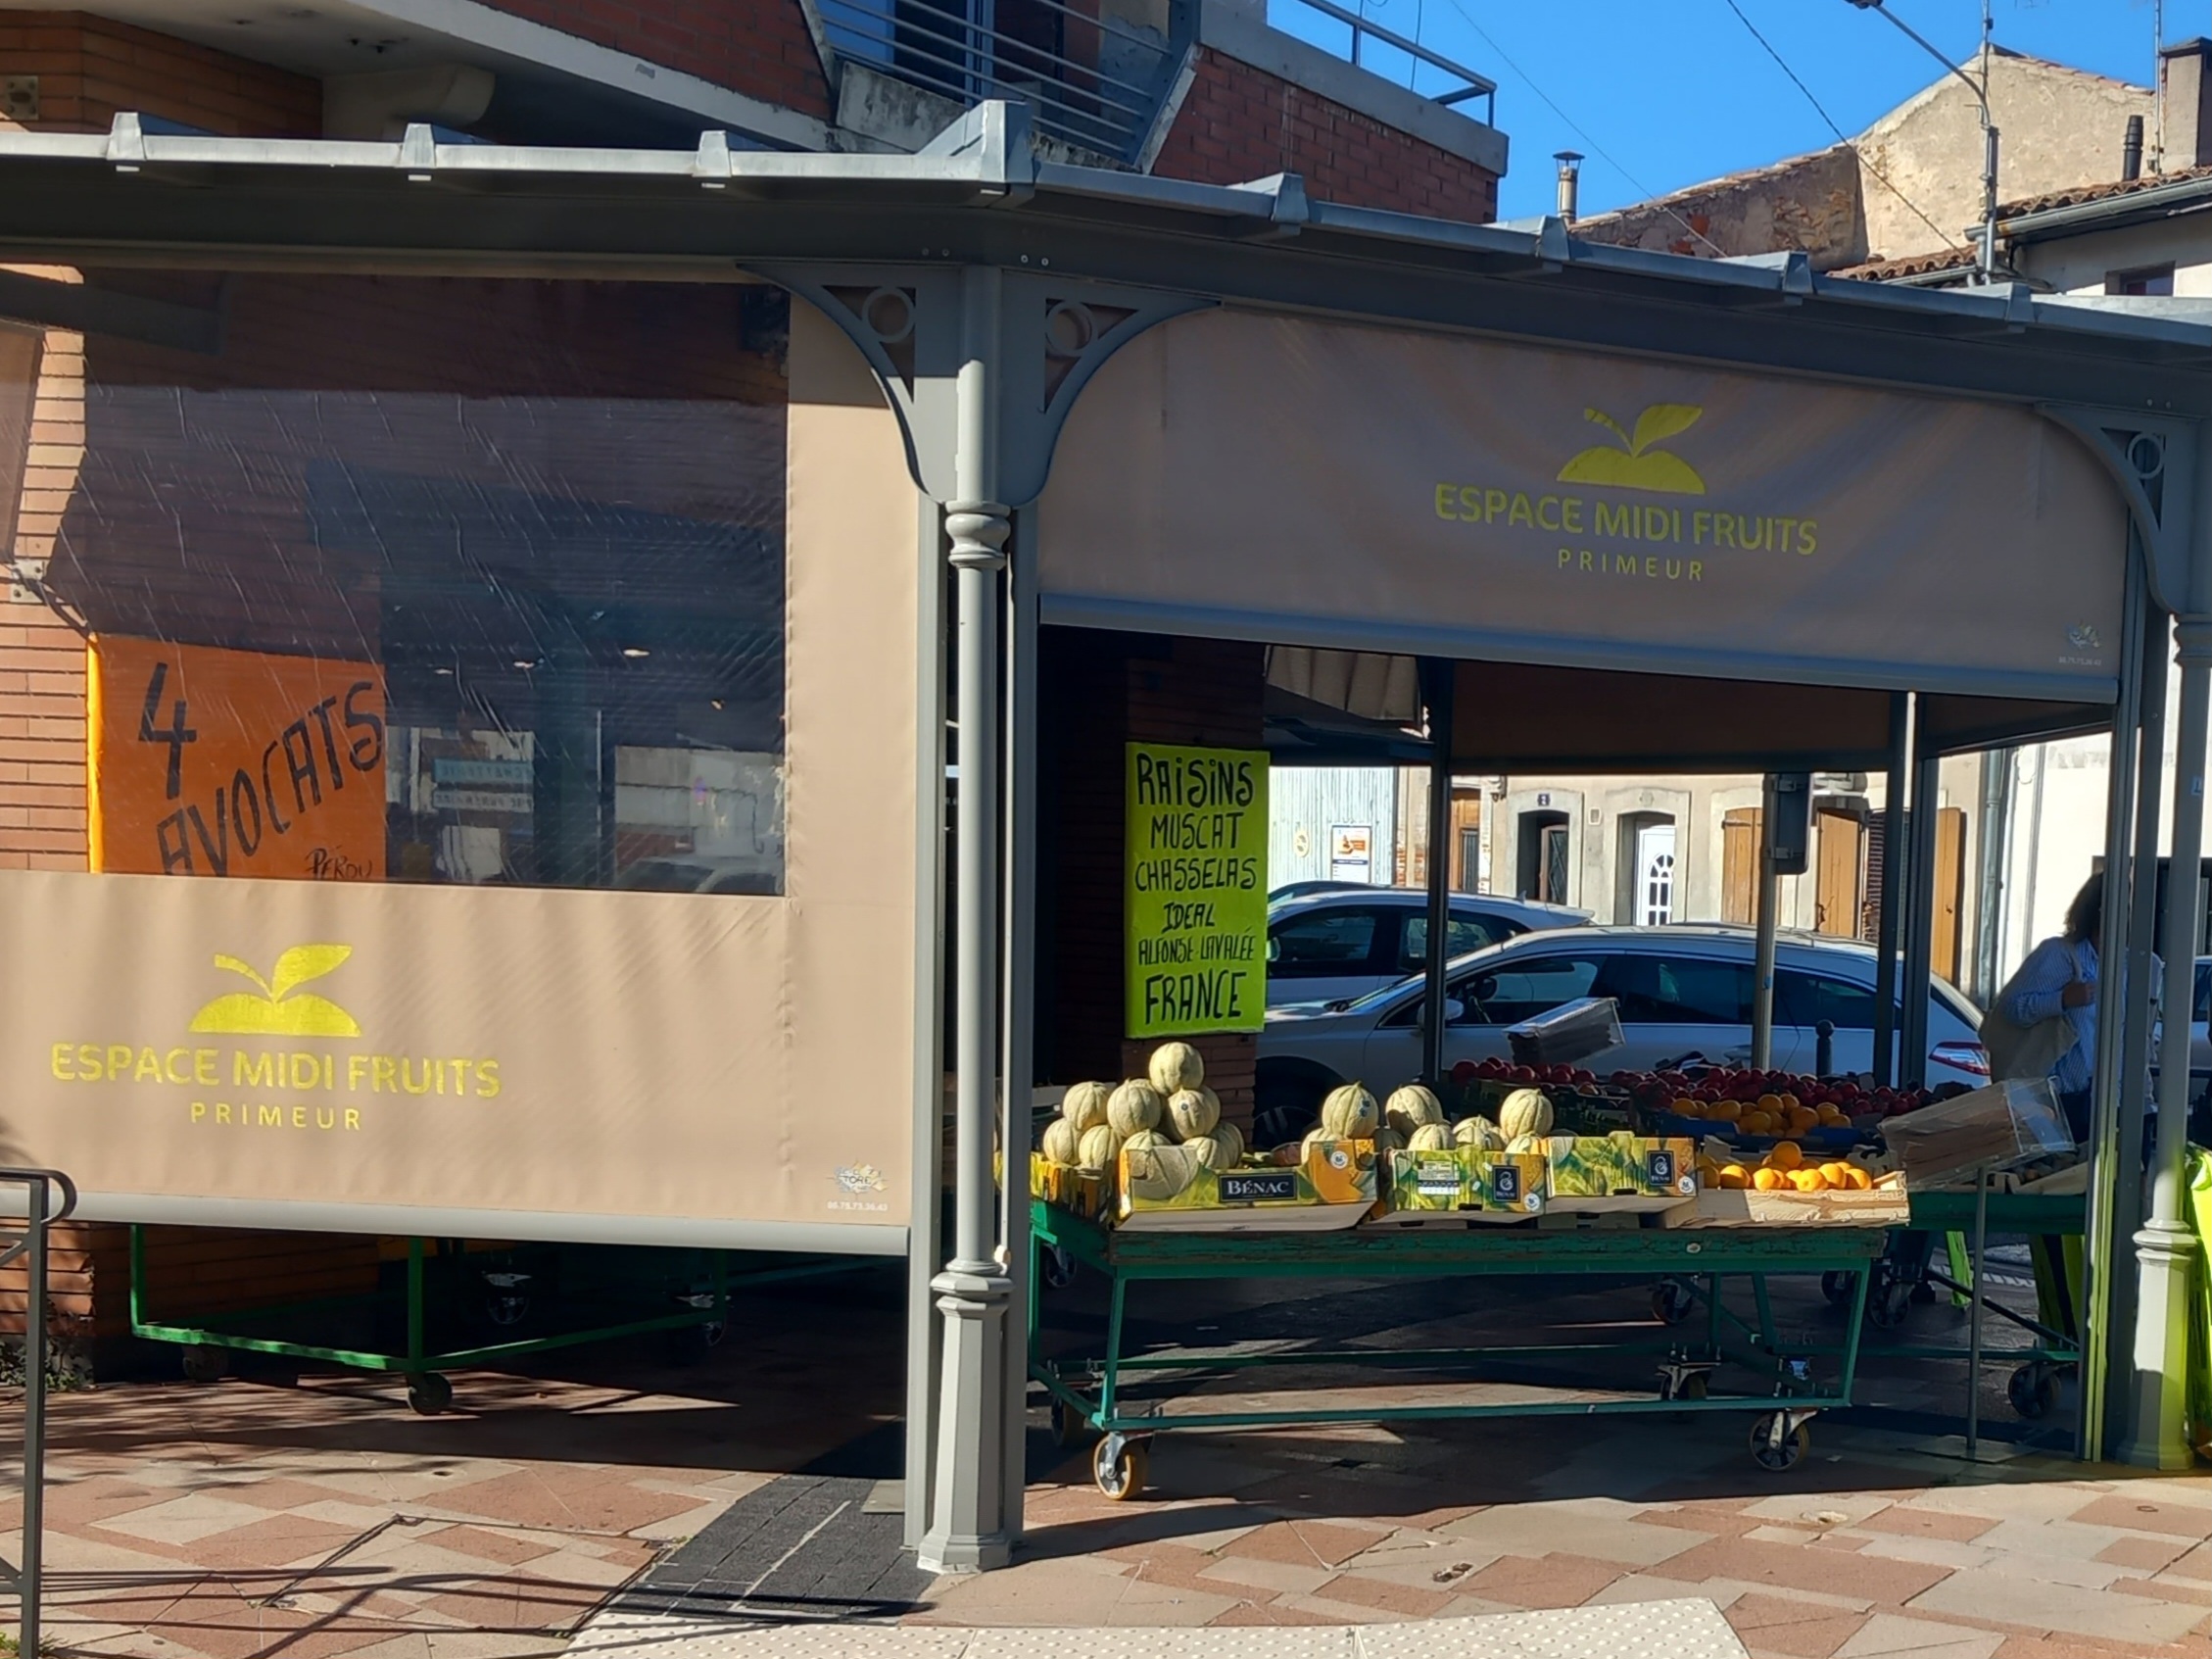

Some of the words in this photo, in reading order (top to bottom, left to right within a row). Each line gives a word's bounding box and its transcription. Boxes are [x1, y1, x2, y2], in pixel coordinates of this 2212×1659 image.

[1434, 483, 1583, 534] ESPACE
[1595, 502, 1681, 543] MIDI
[1693, 512, 1818, 556] FRUITS
[1558, 549, 1703, 581] PRIMEUR
[138, 662, 197, 800] 4
[157, 682, 384, 876] AVOCATS
[1150, 812, 1244, 850] MUSCAT
[1135, 857, 1257, 892] CHASSELAS
[1162, 902, 1216, 934] IDEAL
[1145, 968, 1247, 1025] FRANCE
[51, 1043, 220, 1085] ESPACE
[233, 1049, 333, 1090] MIDI
[348, 1055, 501, 1098] FRUITS
[190, 1102, 361, 1131] PRIMEUR
[1227, 1180, 1289, 1195] BÉNAC
